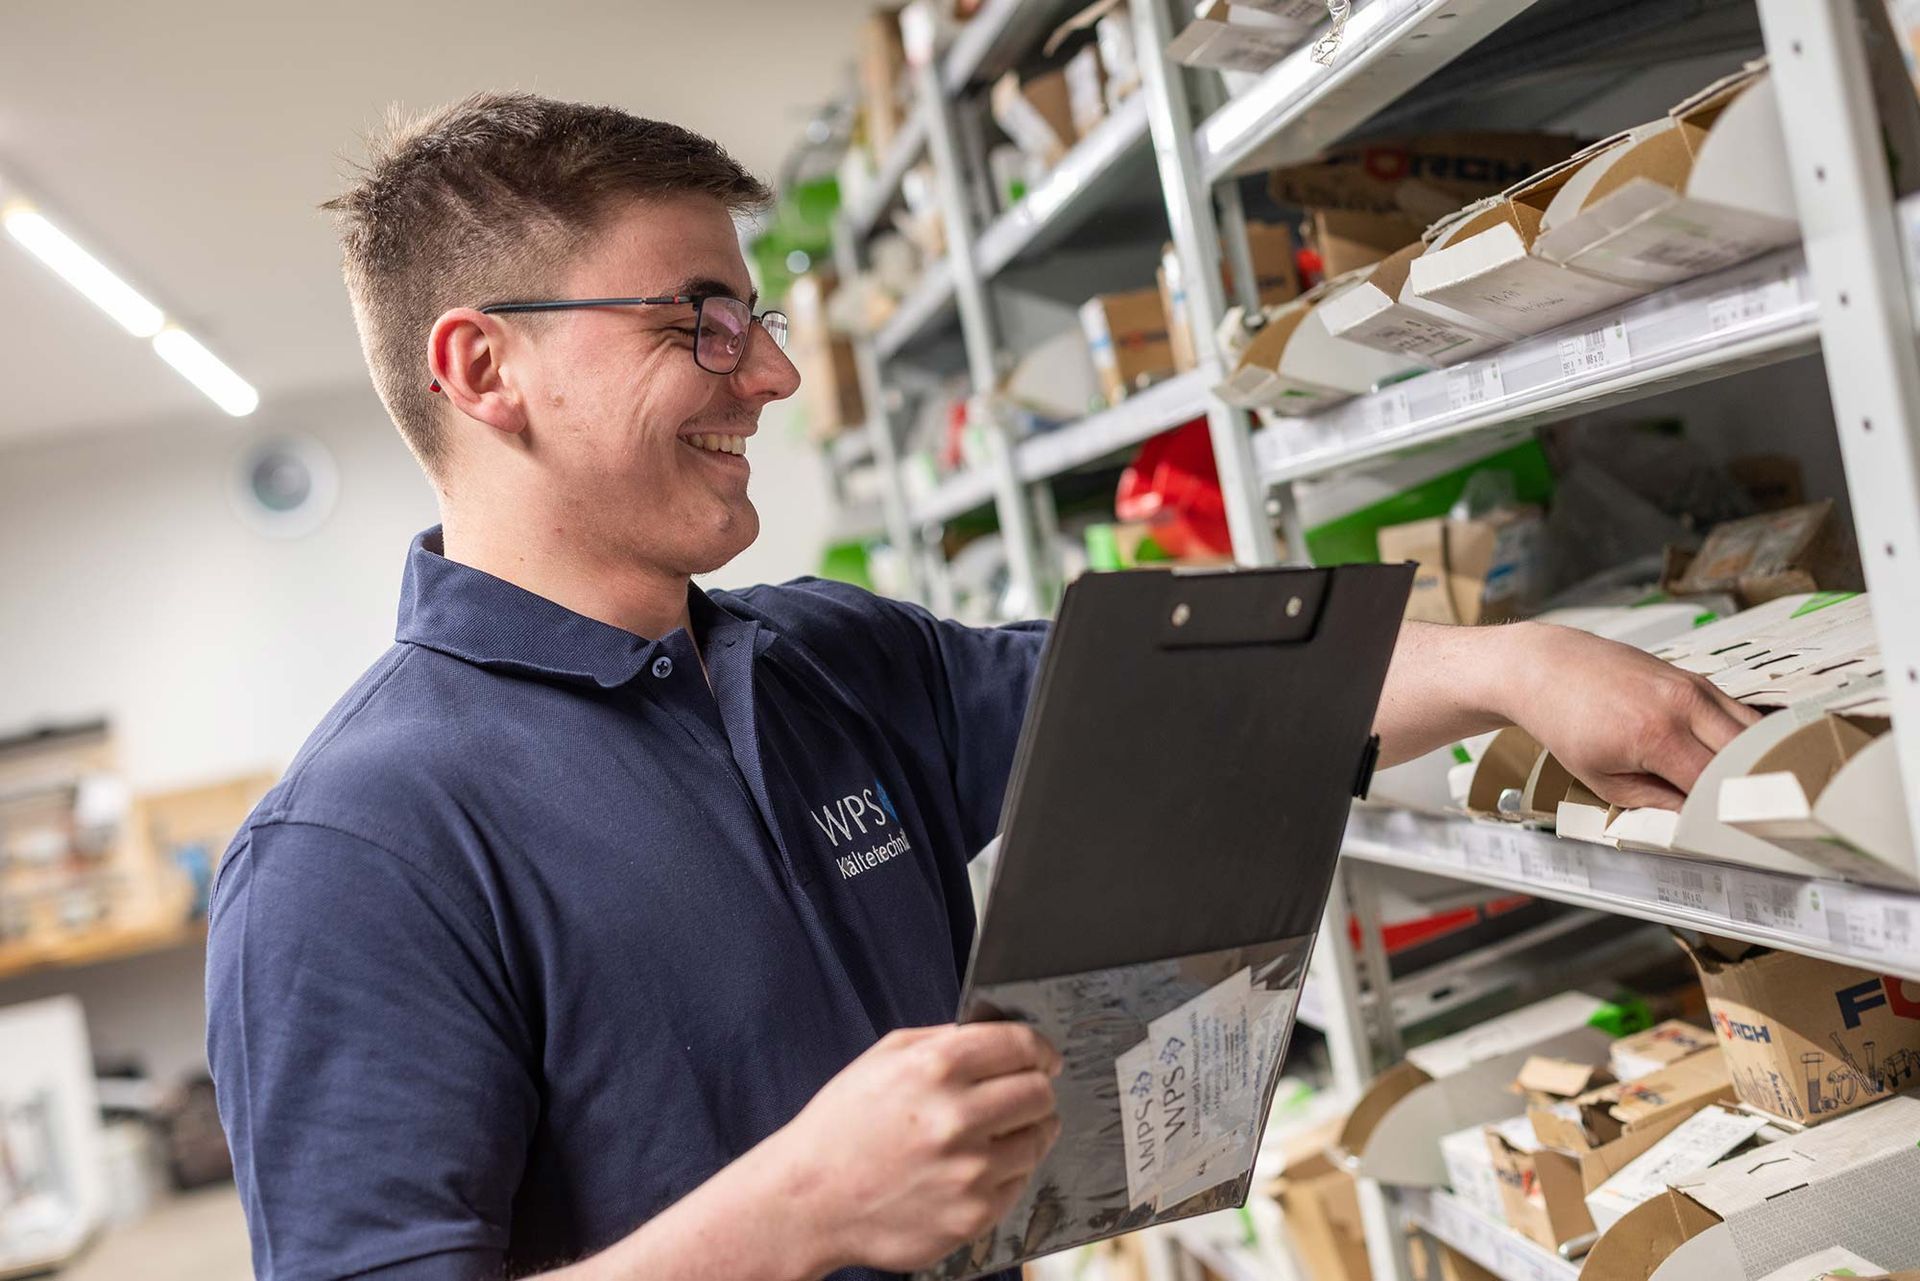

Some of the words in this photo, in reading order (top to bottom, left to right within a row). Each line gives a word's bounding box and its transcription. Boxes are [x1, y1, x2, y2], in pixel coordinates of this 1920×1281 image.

[811, 788, 886, 847] WPS
[1133, 1096, 1155, 1173] WPS
[1161, 1064, 1187, 1143] WPS
